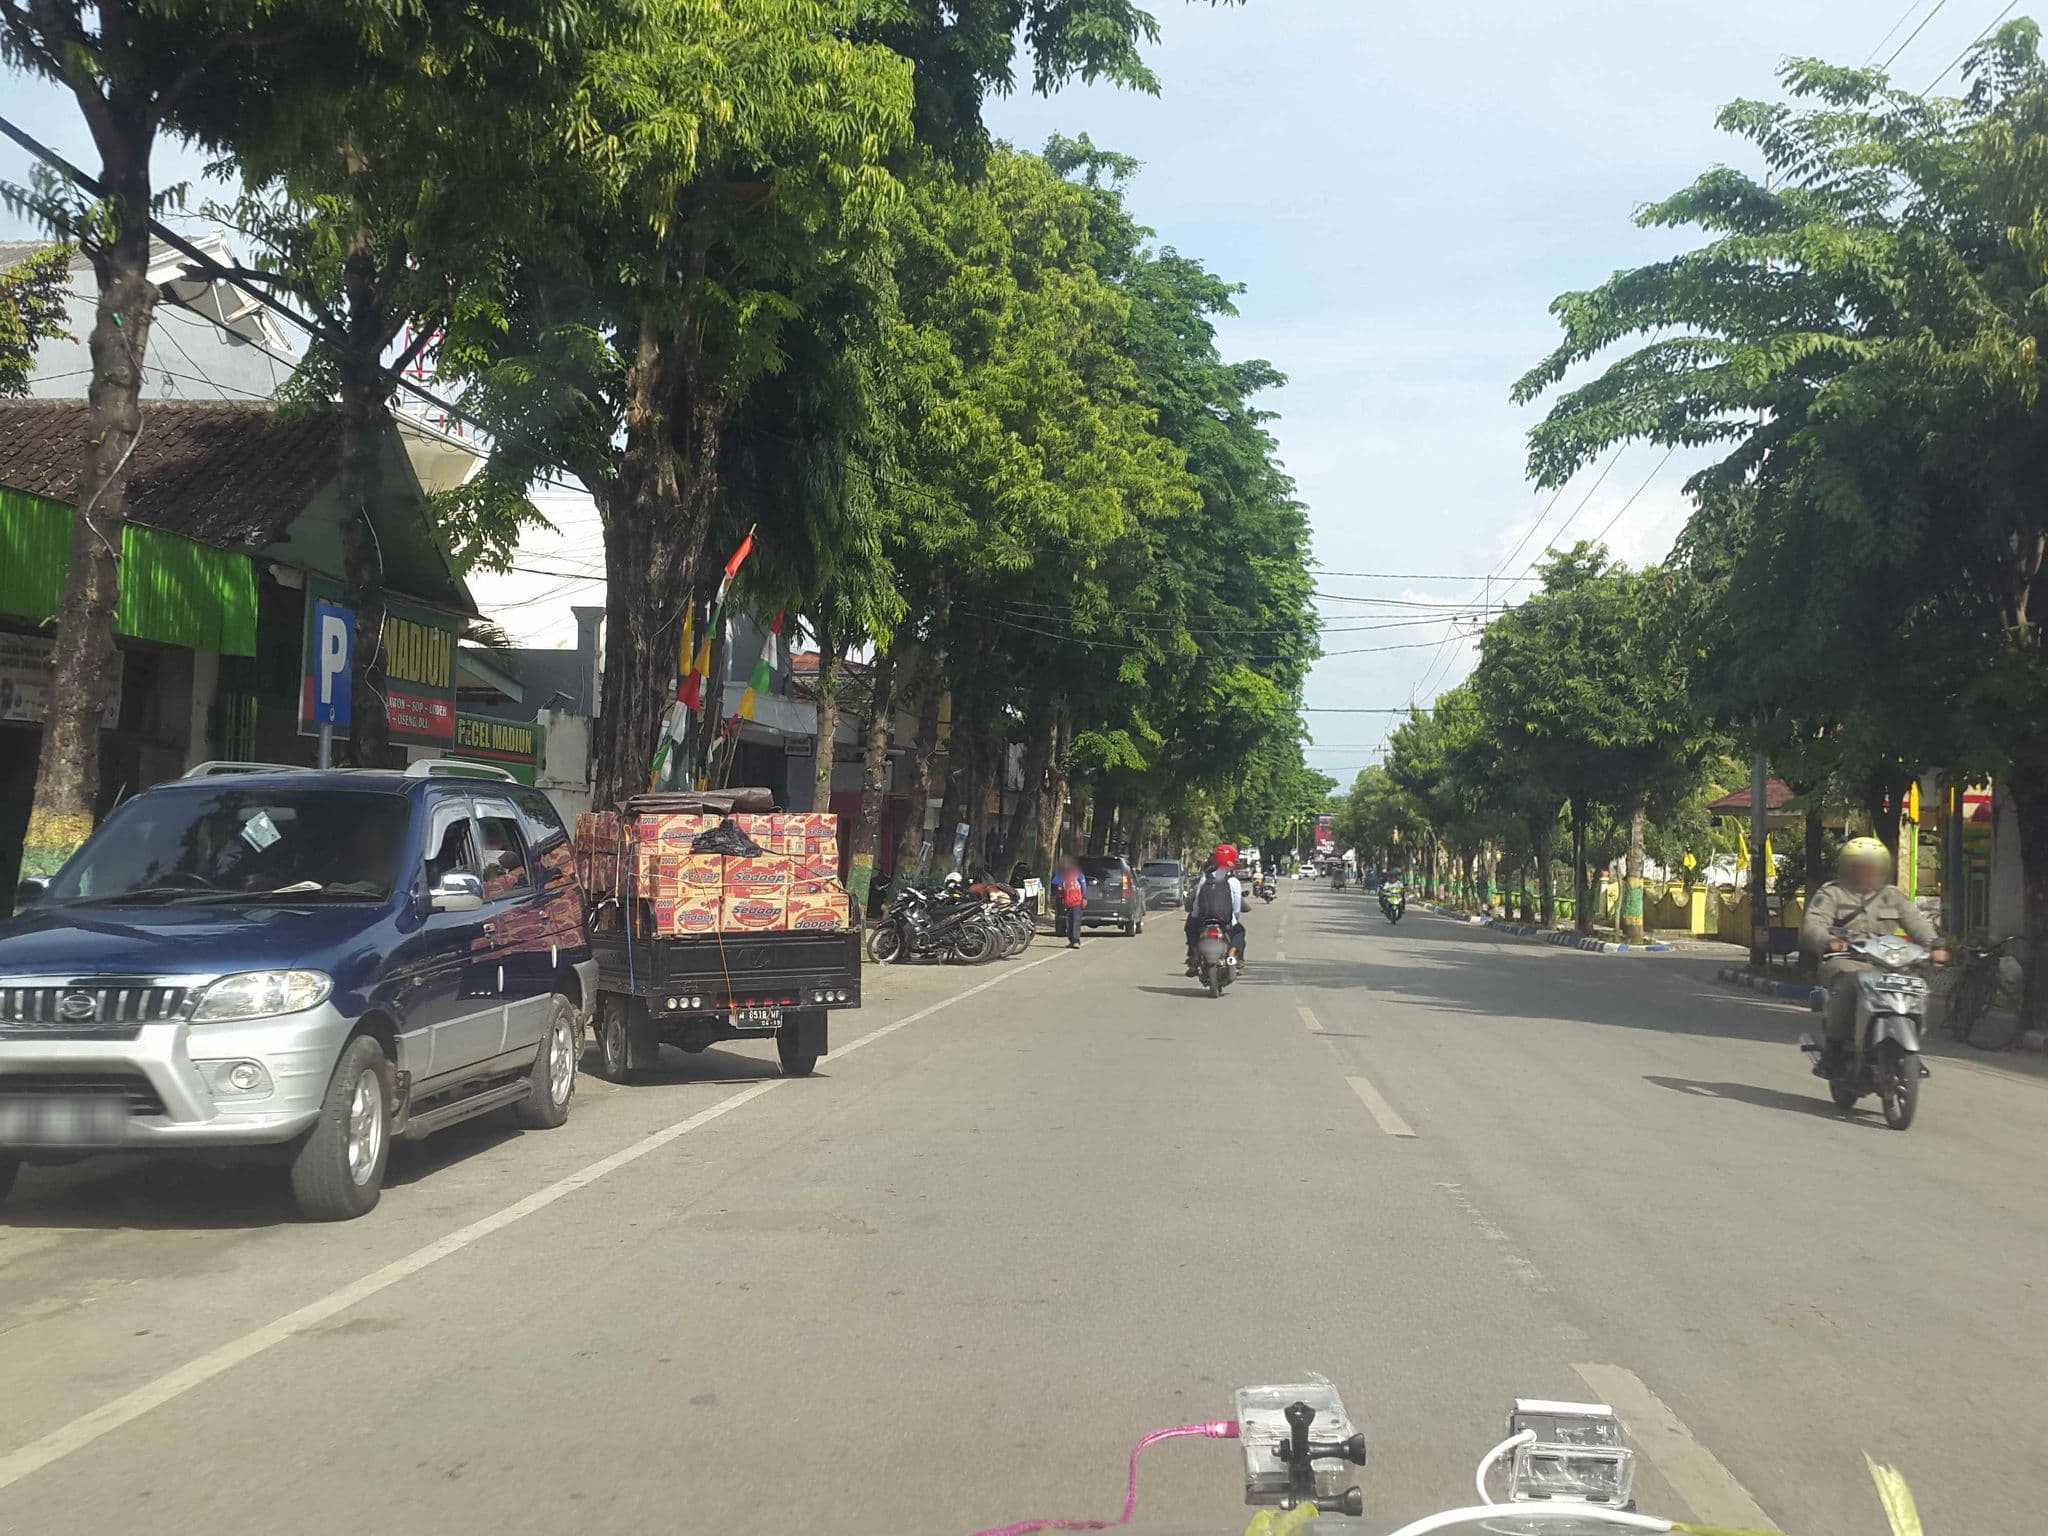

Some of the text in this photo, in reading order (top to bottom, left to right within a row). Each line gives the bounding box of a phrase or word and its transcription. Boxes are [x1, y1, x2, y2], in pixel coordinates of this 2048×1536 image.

[321, 615, 348, 703] P
[384, 617, 450, 689] MADIUN
[492, 724, 532, 754] MADIUN
[733, 871, 786, 885] Sedaap
[732, 905, 782, 915] Sedaap
